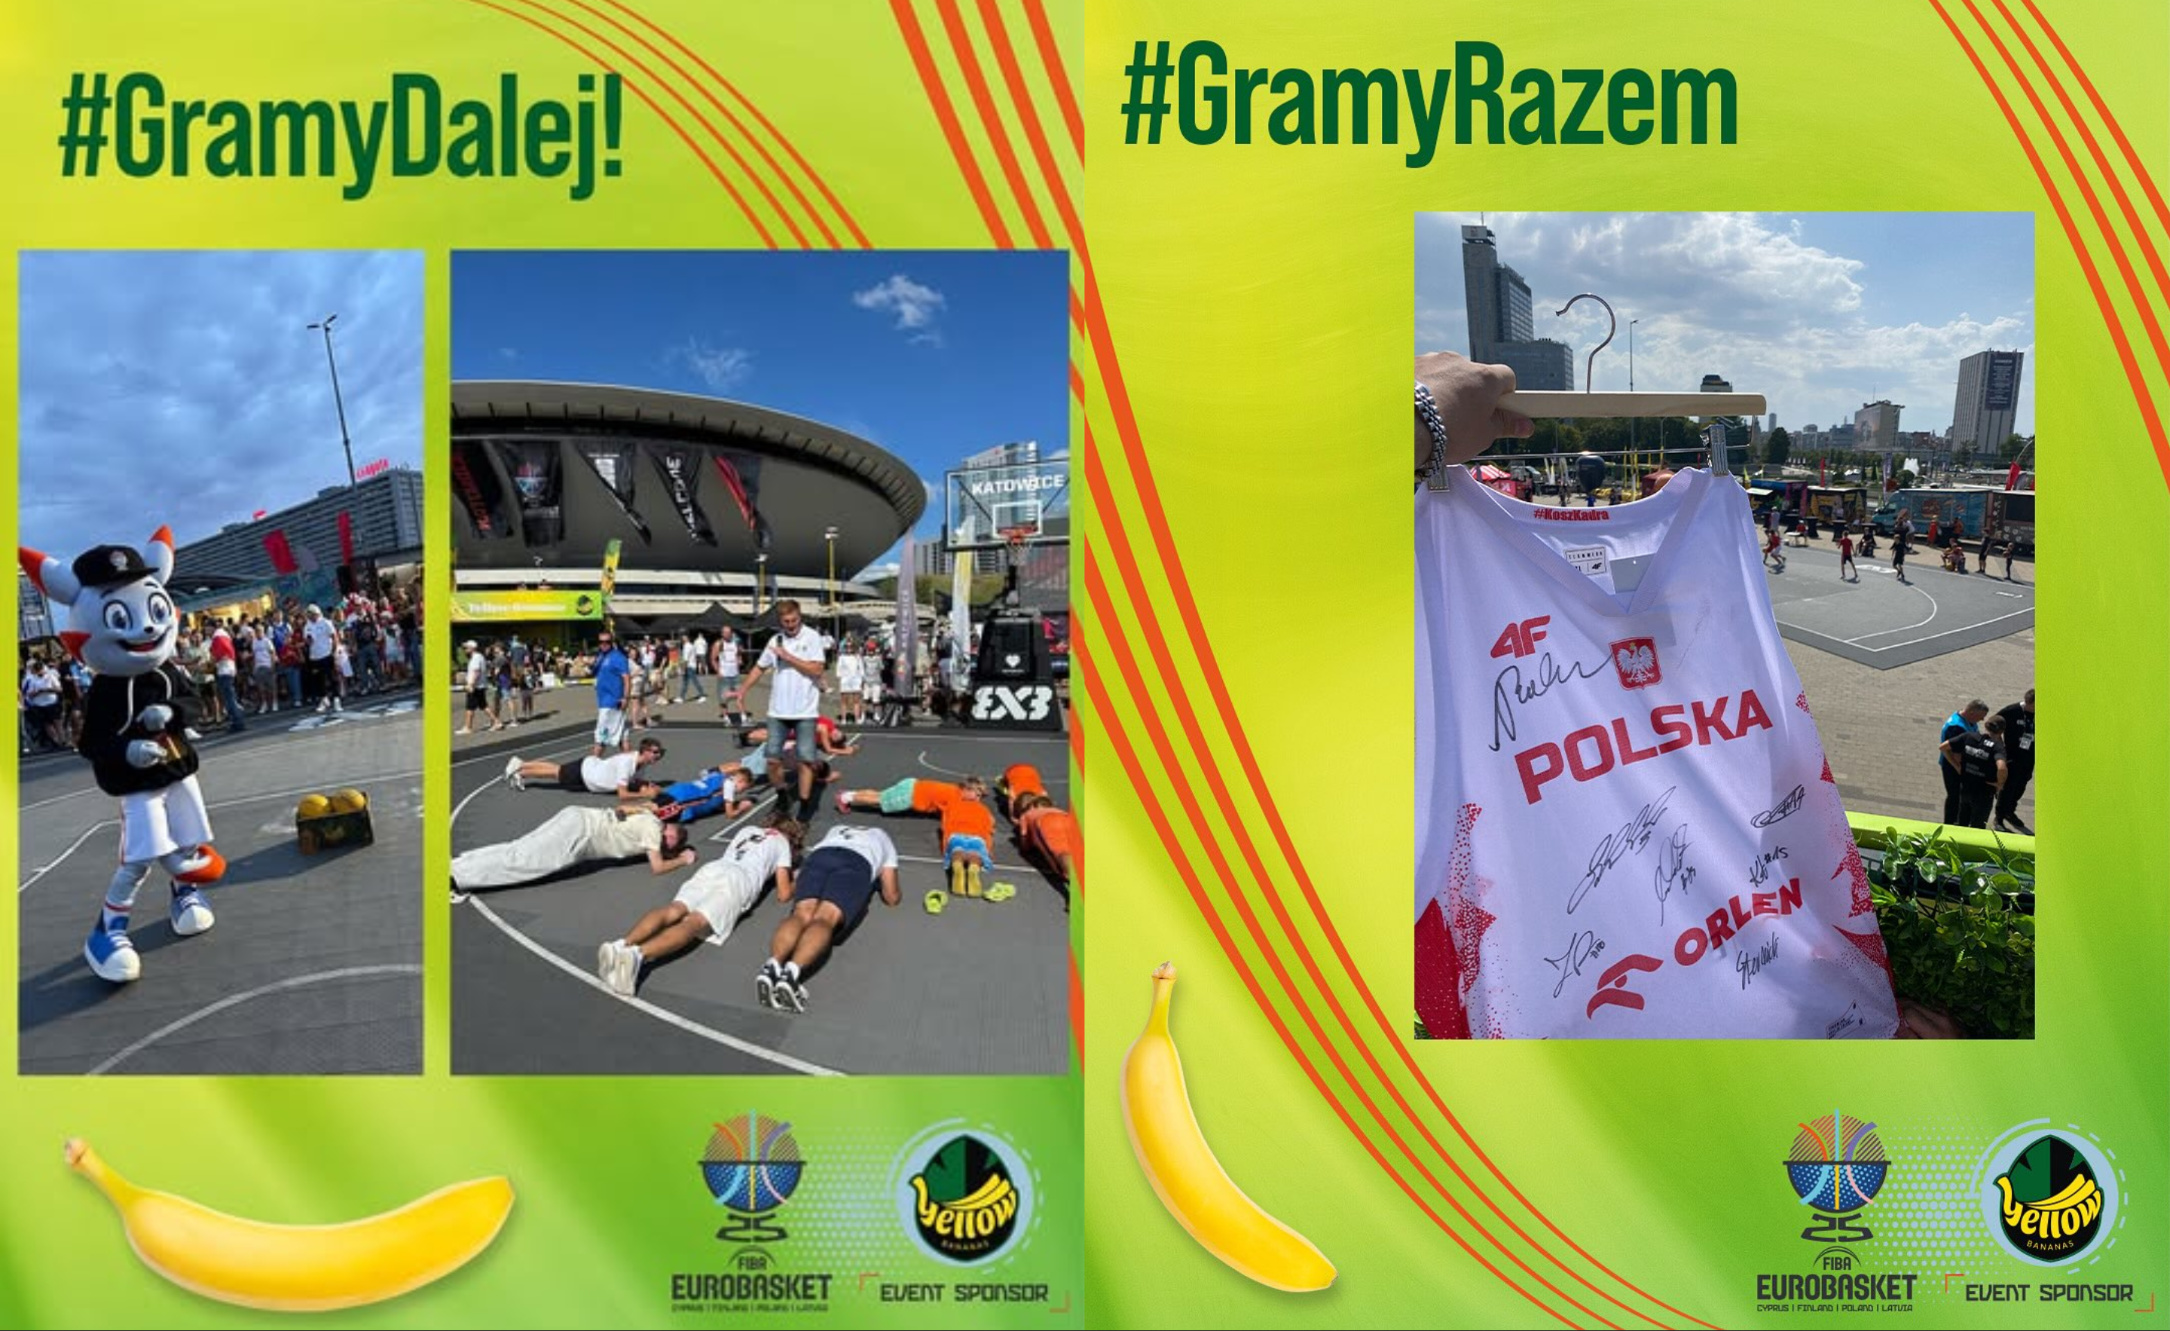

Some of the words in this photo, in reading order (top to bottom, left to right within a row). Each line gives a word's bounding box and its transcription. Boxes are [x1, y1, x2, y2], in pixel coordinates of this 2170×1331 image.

[972, 474, 1065, 495] KATOWICE
[1533, 508, 1610, 521] #KoszKadra
[1490, 615, 1551, 659] 4F
[1514, 688, 1774, 805] POLSKA
[1674, 877, 1804, 967] ORLEN
